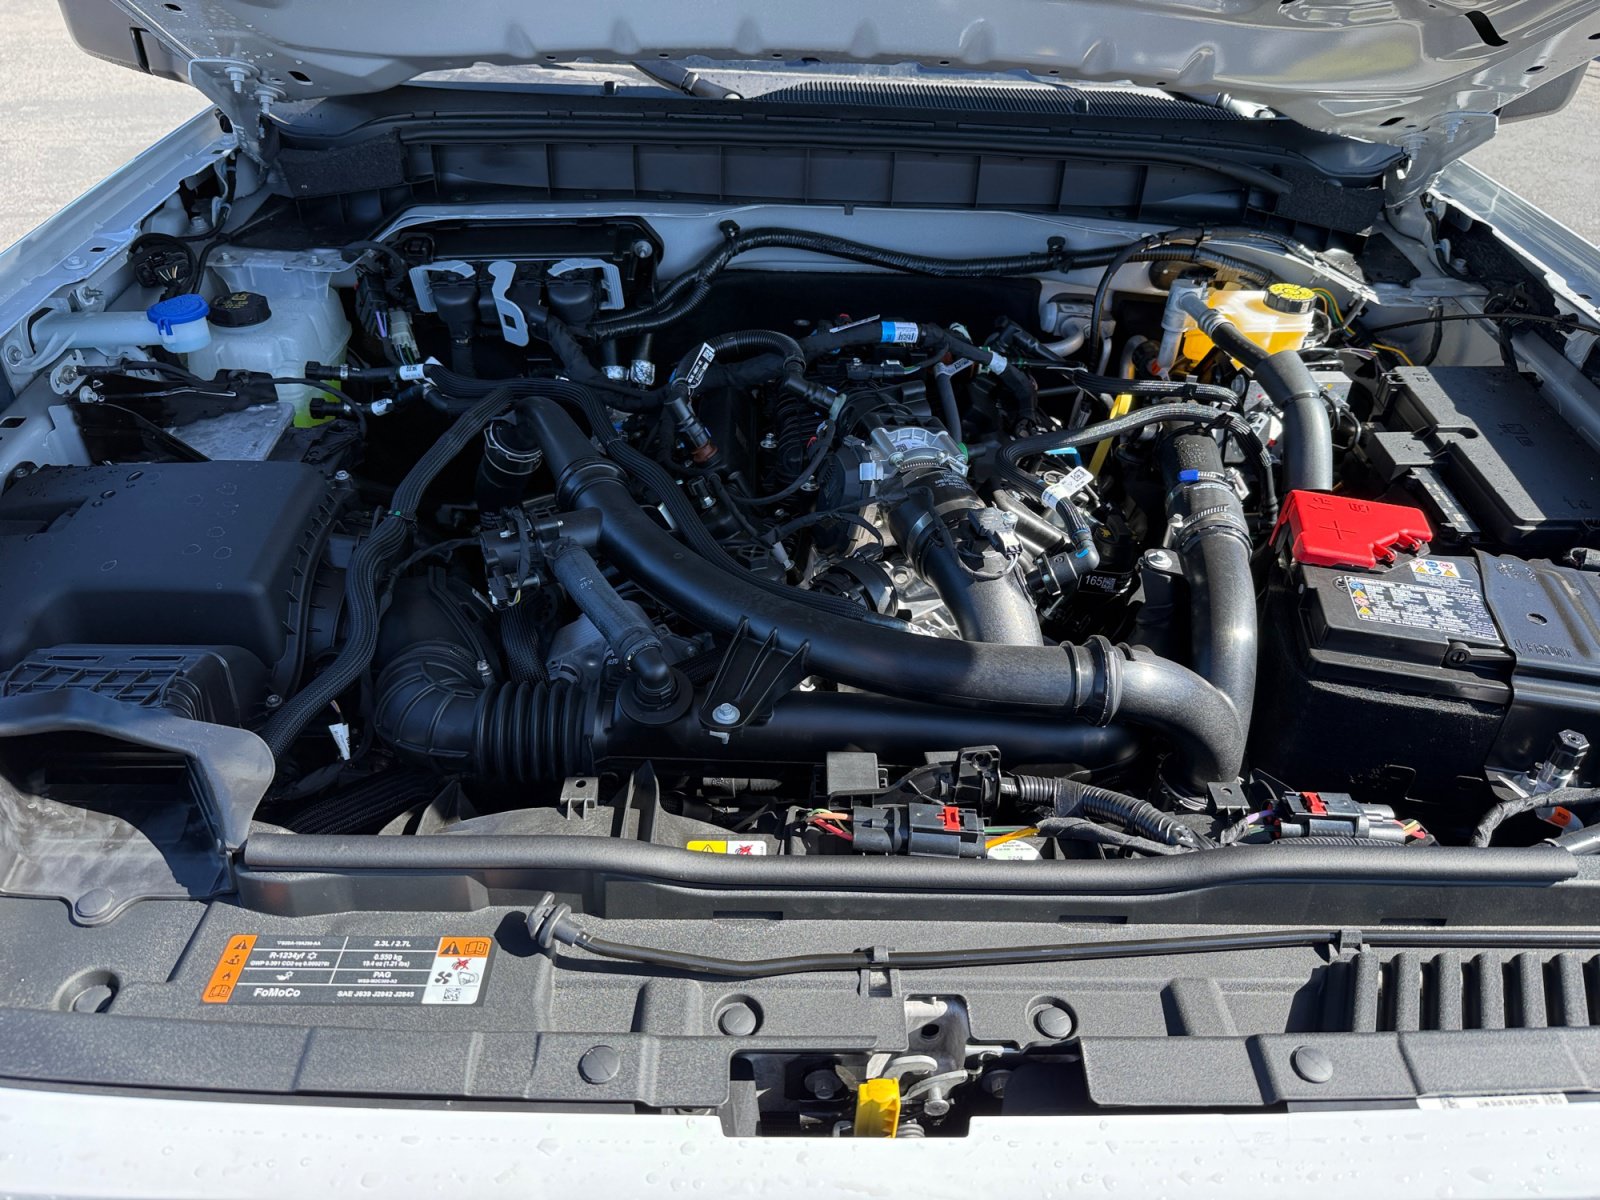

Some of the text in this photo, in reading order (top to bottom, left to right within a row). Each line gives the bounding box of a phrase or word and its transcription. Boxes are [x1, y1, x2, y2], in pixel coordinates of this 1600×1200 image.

[1086, 575, 1103, 586] 165
[269, 951, 306, 960] R-1234yf
[393, 953, 403, 962] kg
[372, 971, 392, 979] PAG
[253, 987, 301, 998] FoMoCo
[336, 990, 354, 998] SAE
